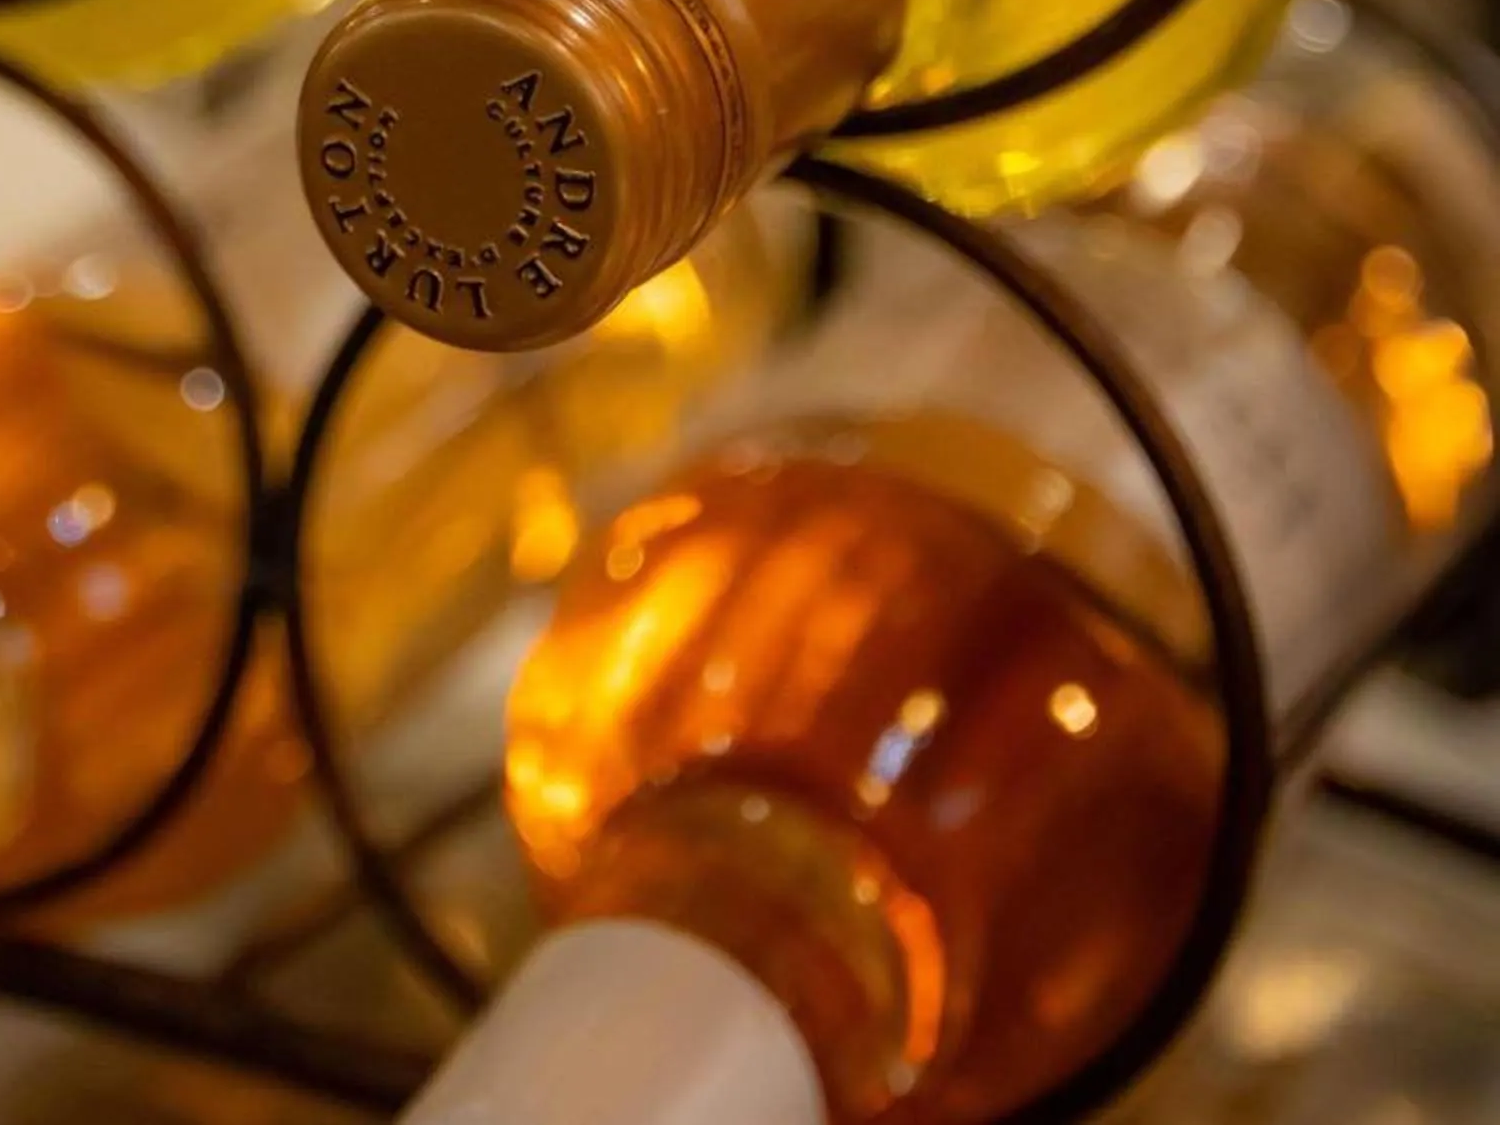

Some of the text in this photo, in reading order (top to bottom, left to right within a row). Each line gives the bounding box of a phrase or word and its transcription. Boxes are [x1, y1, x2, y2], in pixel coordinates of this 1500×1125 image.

[321, 71, 596, 318] ANDRE LURTON
[487, 100, 543, 244] CULTURE
